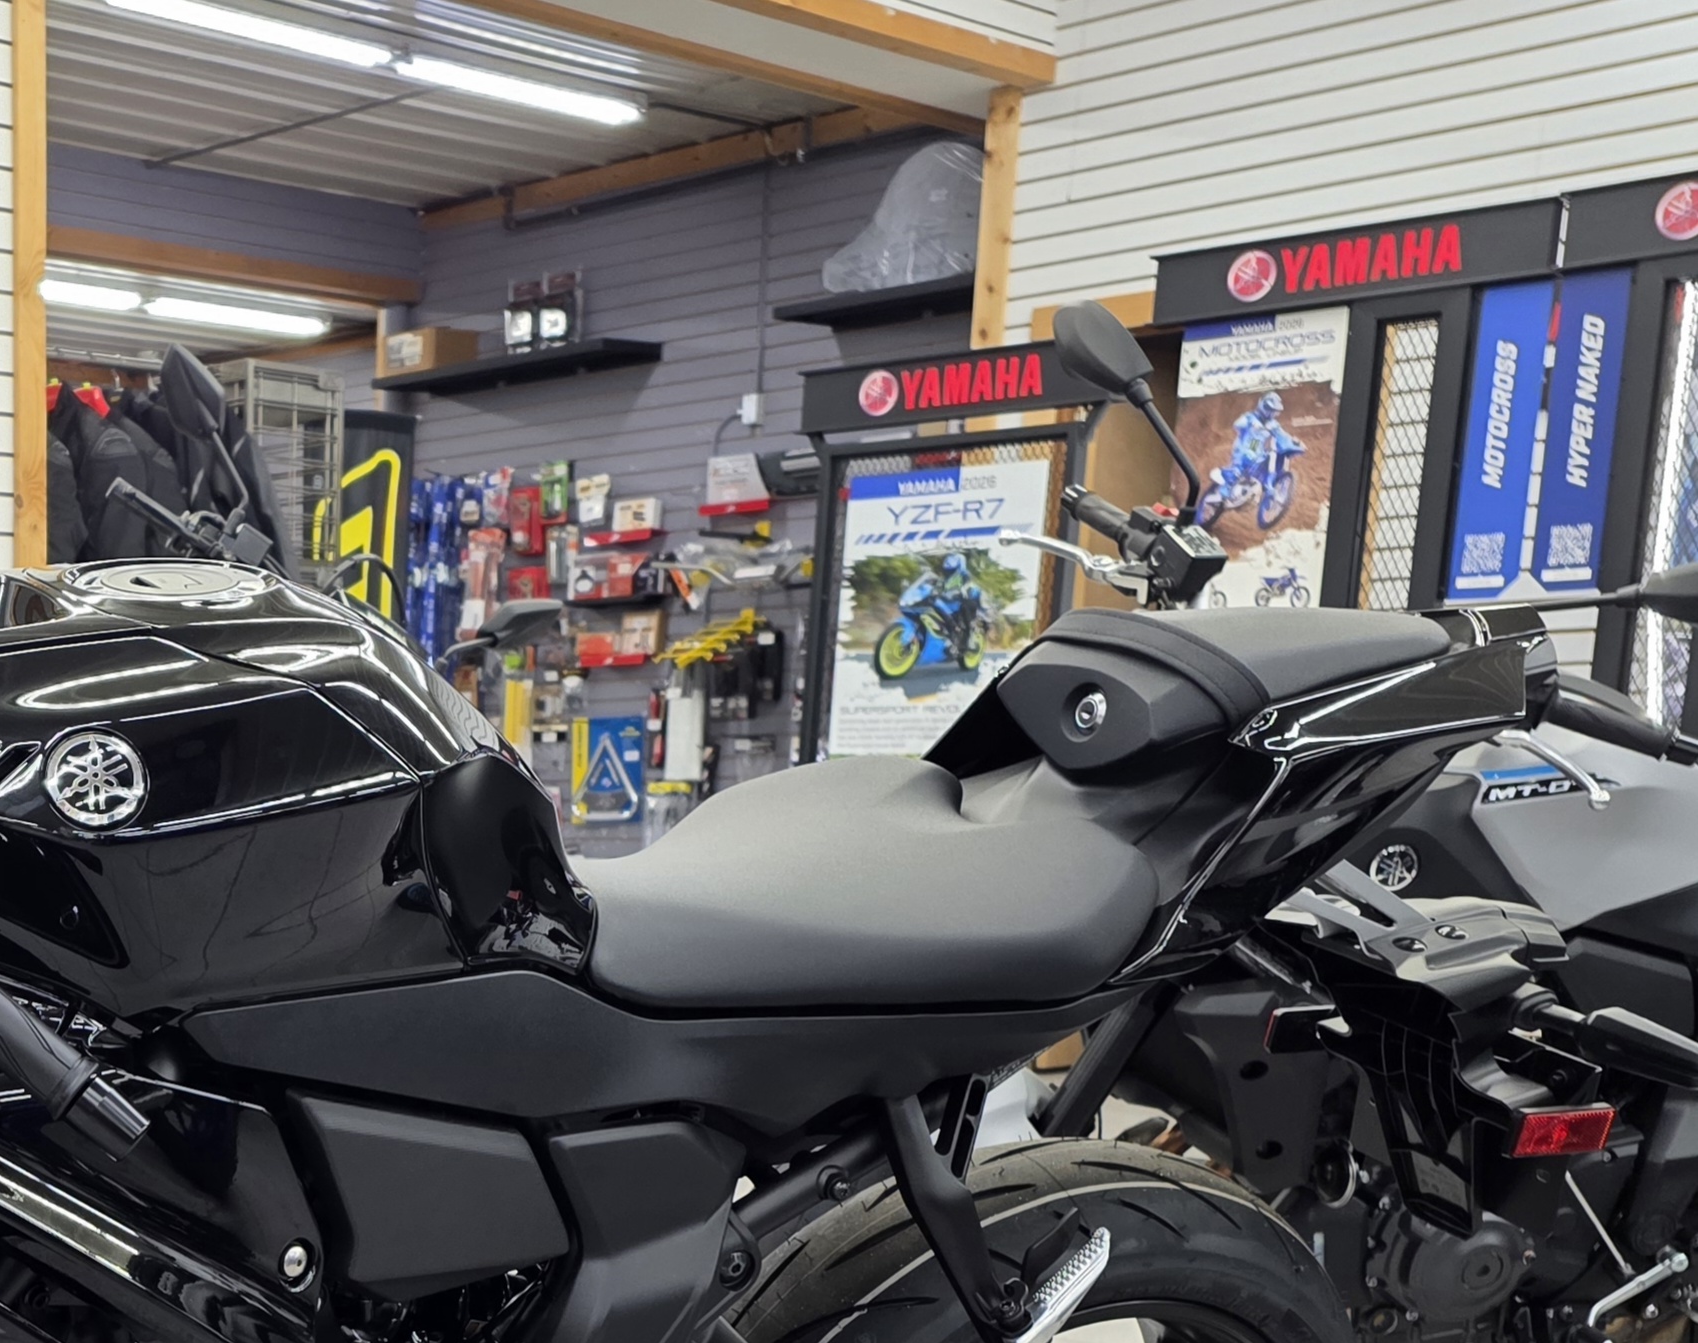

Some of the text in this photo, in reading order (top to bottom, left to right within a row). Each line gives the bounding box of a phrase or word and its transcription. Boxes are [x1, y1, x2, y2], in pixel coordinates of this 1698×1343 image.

[1281, 224, 1462, 293] YAMAHA
[1199, 328, 1337, 359] MOTOCROSS
[901, 353, 1043, 410] YAMAHA
[1565, 313, 1606, 488] HYPER NAKED
[1481, 339, 1519, 489] MOTOCROSS
[897, 475, 998, 496] YAMAHA 2026
[886, 498, 1005, 527] YZF-R7
[1487, 779, 1577, 802] MT-0
